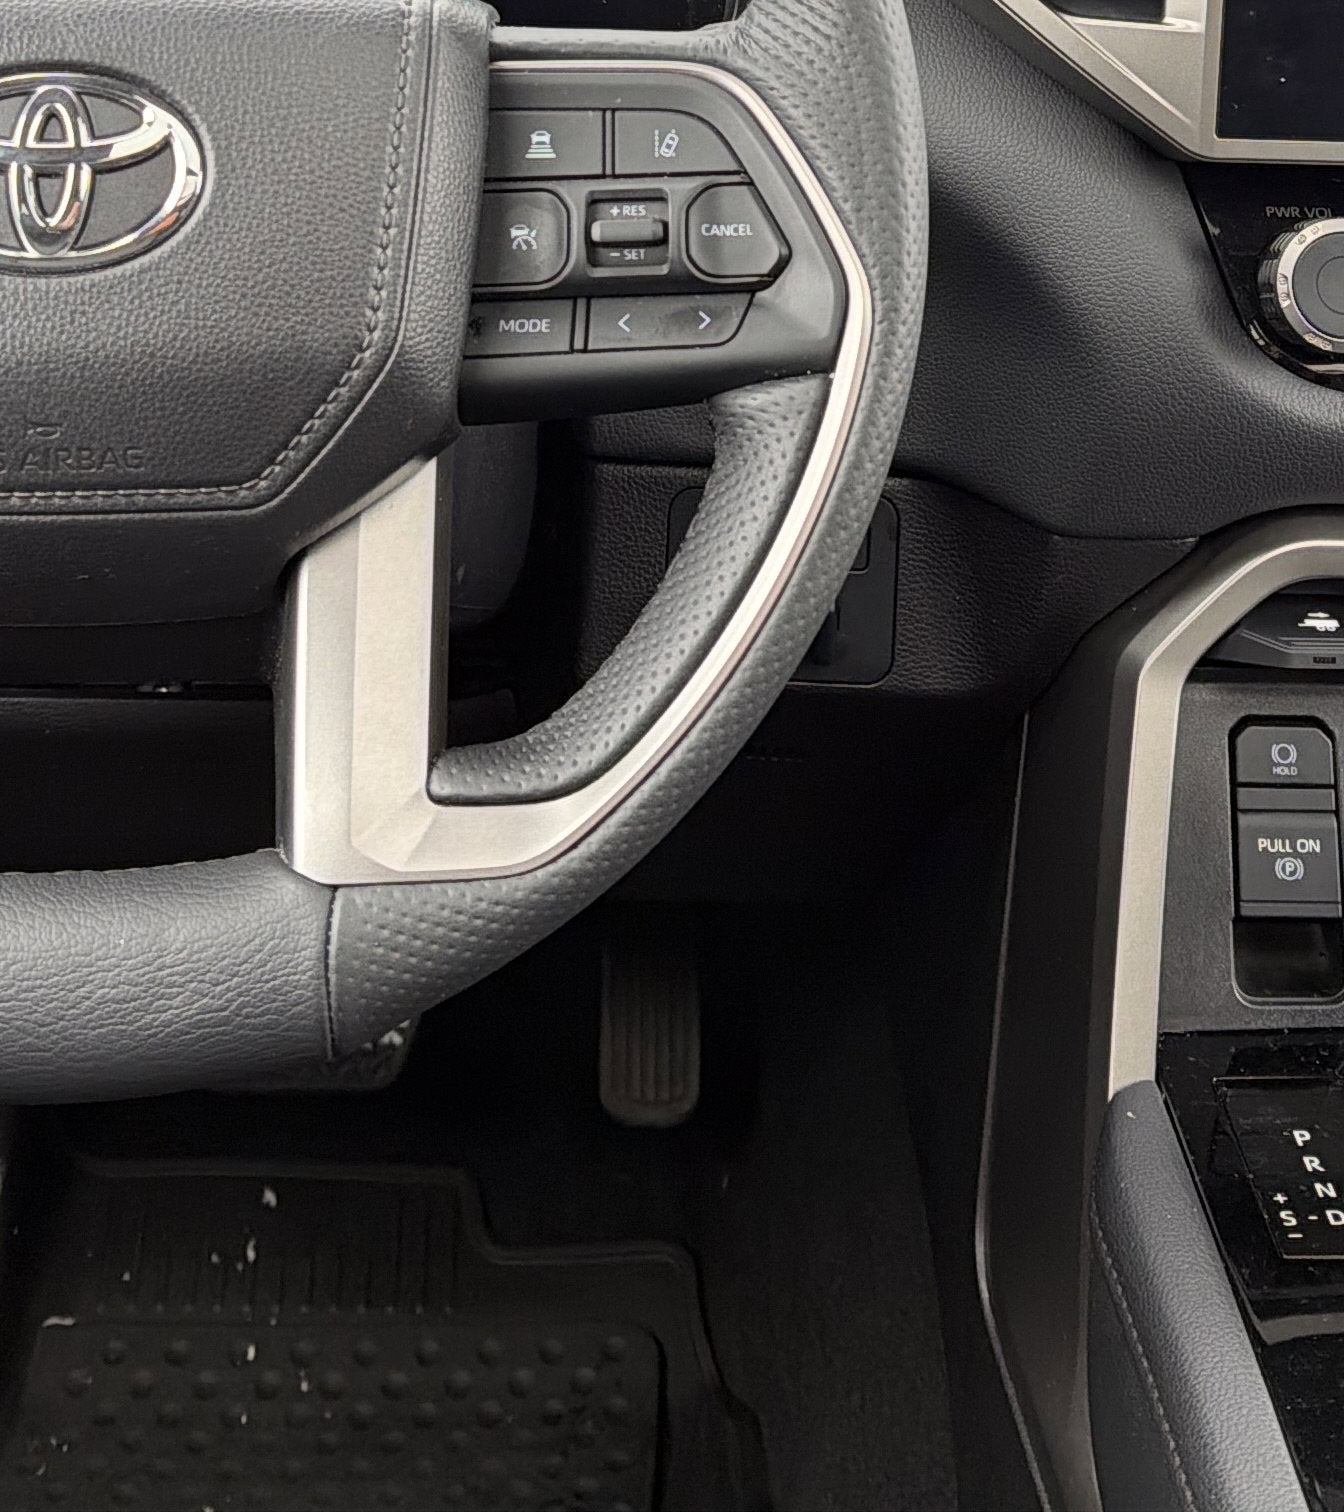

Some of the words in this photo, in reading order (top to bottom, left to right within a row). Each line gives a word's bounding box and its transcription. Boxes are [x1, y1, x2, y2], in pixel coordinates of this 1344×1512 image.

[1265, 206, 1302, 219] PWR
[701, 223, 753, 238] CANCEL
[623, 248, 646, 261] SET
[498, 318, 551, 333] MODE
[19, 446, 147, 474] AIRBAG
[1272, 766, 1298, 776] HOLD
[1257, 838, 1293, 853] PULL
[1296, 839, 1321, 853] ON
[1292, 1129, 1311, 1147] P
[1302, 1156, 1326, 1172] R
[1313, 1182, 1337, 1198] N
[1279, 1210, 1298, 1227] S
